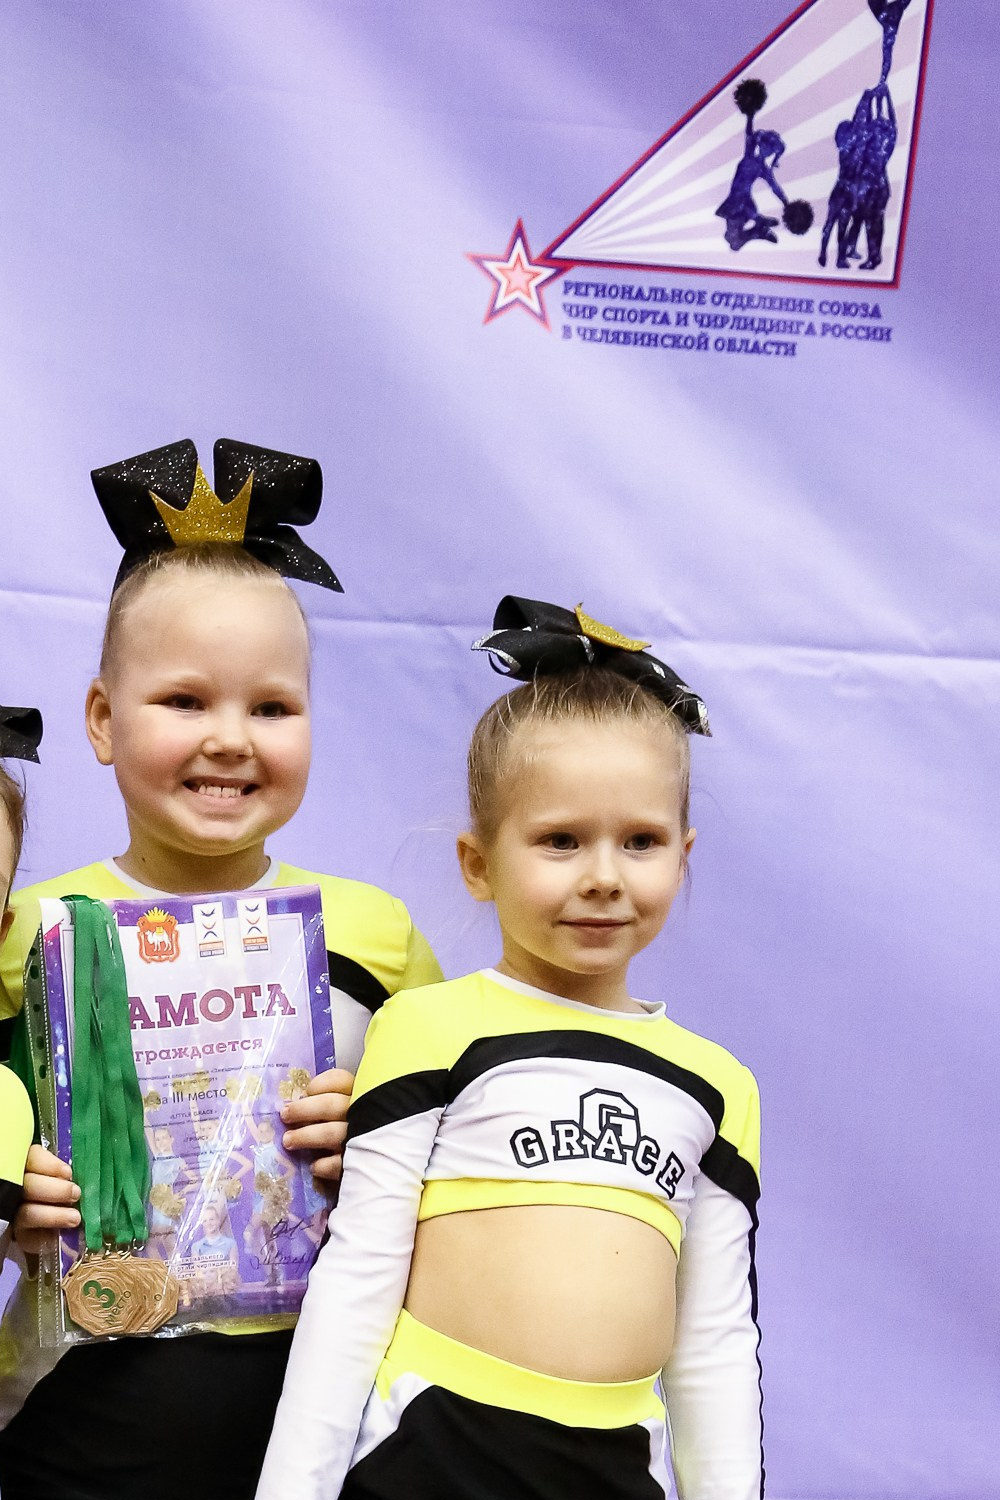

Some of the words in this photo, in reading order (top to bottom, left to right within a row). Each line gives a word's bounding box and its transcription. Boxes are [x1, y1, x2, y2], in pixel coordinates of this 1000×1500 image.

[563, 280, 707, 305] РЕГИОНАЛЬНОЕ
[711, 291, 814, 314] ОТДЕЛЕНИЕ
[818, 300, 882, 319] СОЮЗА
[562, 303, 598, 320] ЧИР
[602, 305, 671, 326] СПОРТА
[675, 311, 689, 327] И
[693, 312, 817, 336] ЧИРЛИДИНГА
[821, 321, 893, 342] РОССИИ
[577, 326, 710, 351] ЧЕЛЯБИНСКОЙ
[714, 336, 798, 357] ОБЛАСТИ
[127, 983, 297, 1031] АМОТА
[134, 1037, 264, 1066] граждается
[172, 1091, 185, 1104] III
[188, 1088, 228, 1102] место
[509, 1119, 685, 1200] GRACE
